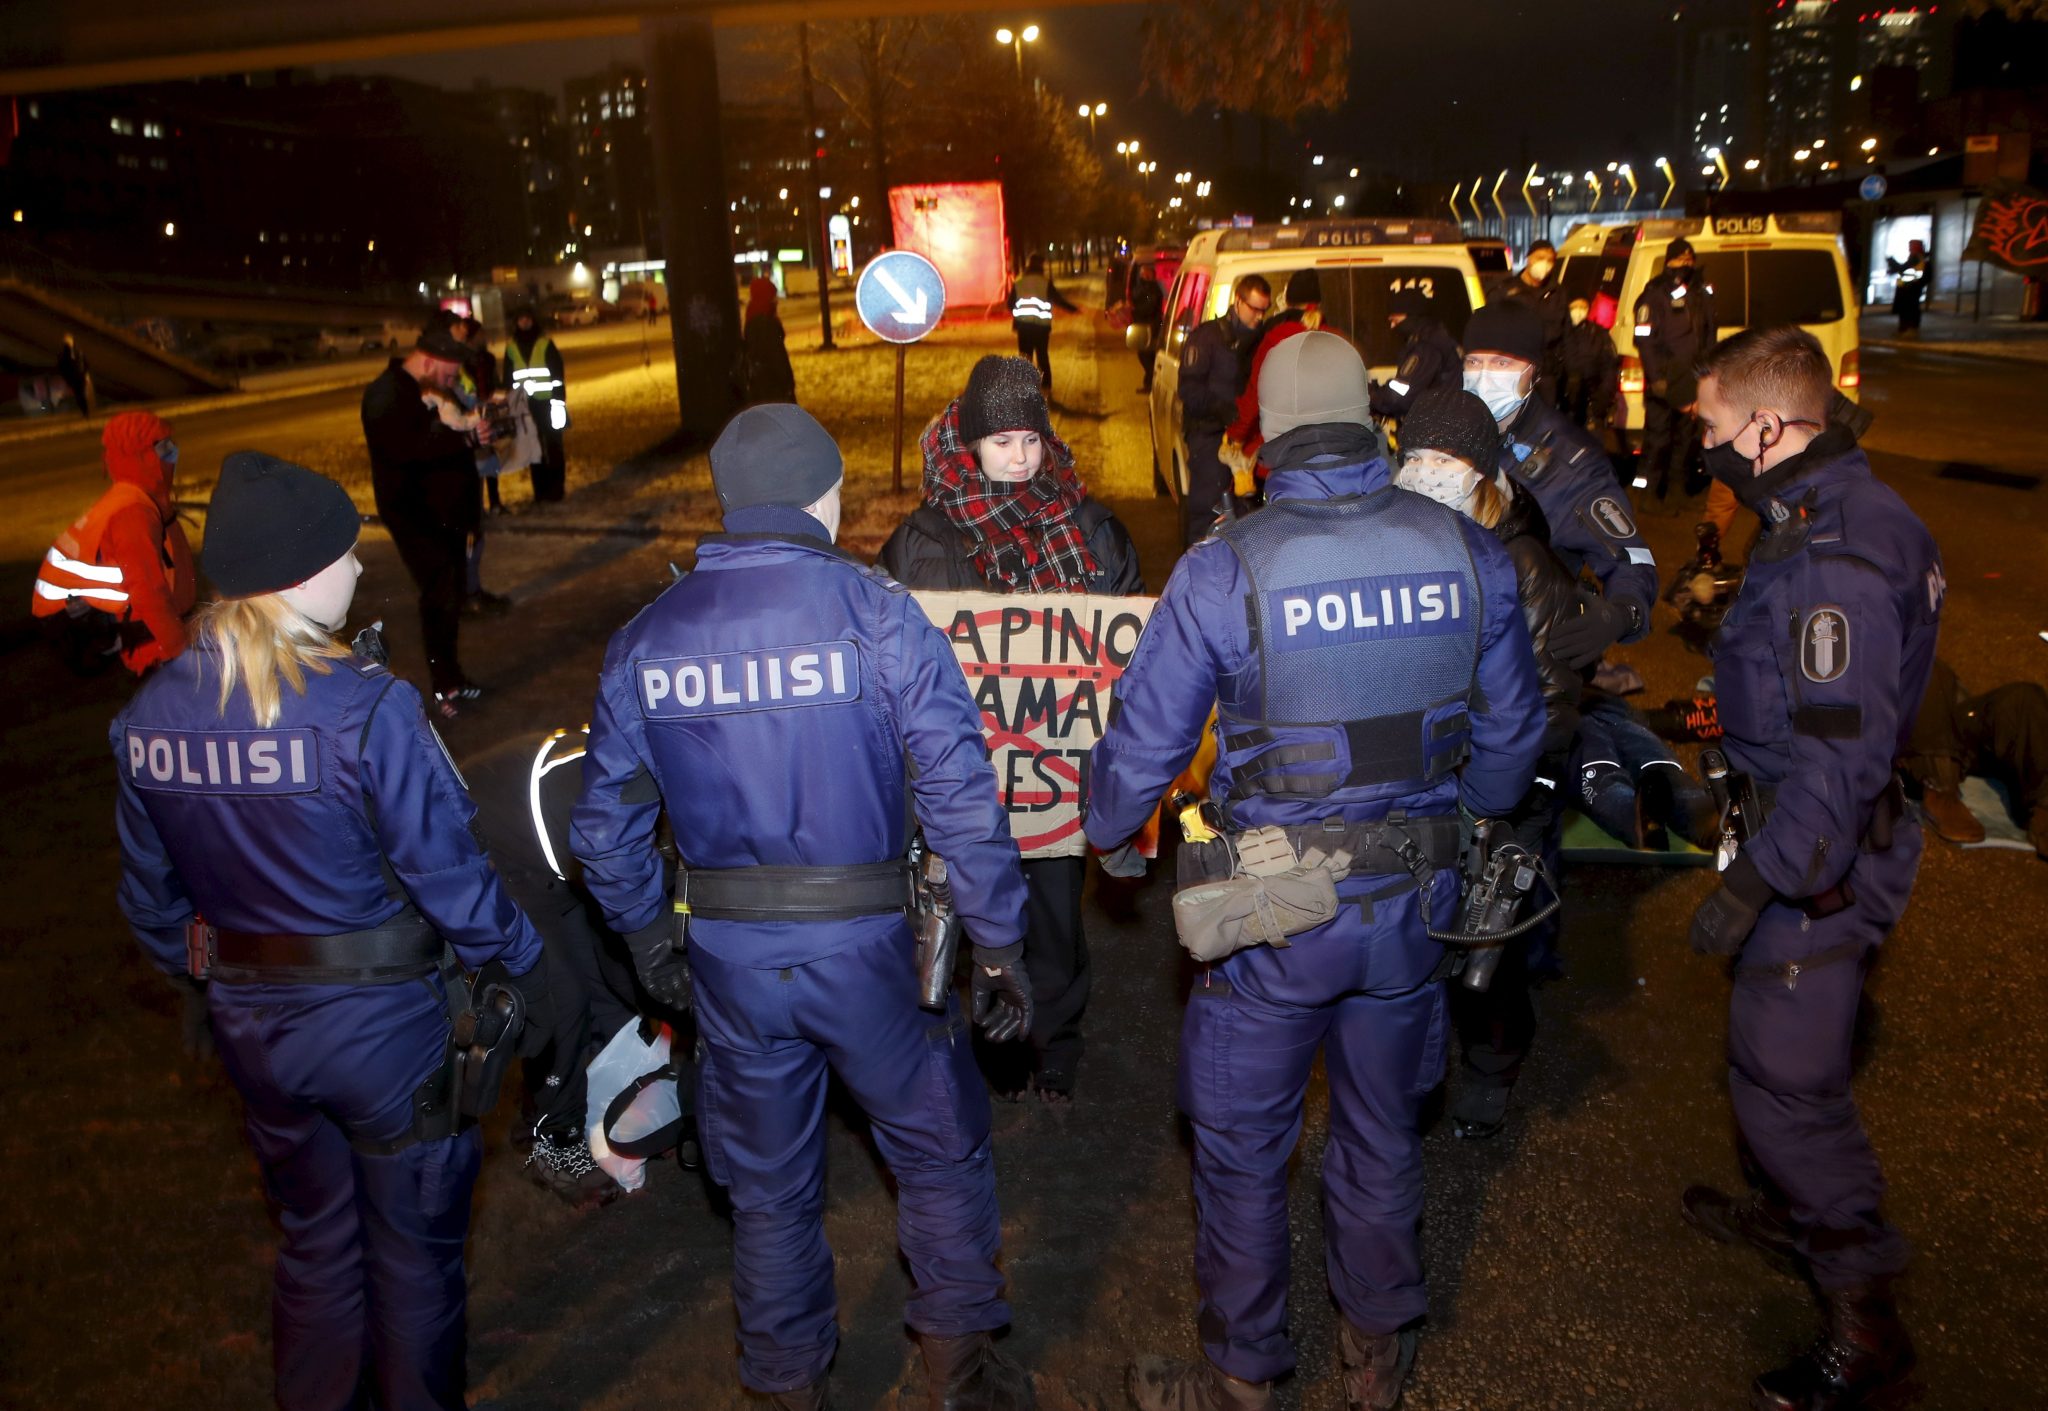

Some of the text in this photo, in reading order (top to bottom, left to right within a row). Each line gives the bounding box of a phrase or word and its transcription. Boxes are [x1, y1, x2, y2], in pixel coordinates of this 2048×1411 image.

[1318, 230, 1373, 246] POLIS
[1716, 217, 1764, 234] POLIS
[1283, 583, 1460, 636] POLIISI
[643, 651, 846, 710] POLIISI
[974, 666, 1122, 738] ÄMÄ
[128, 735, 307, 785] POLIISI
